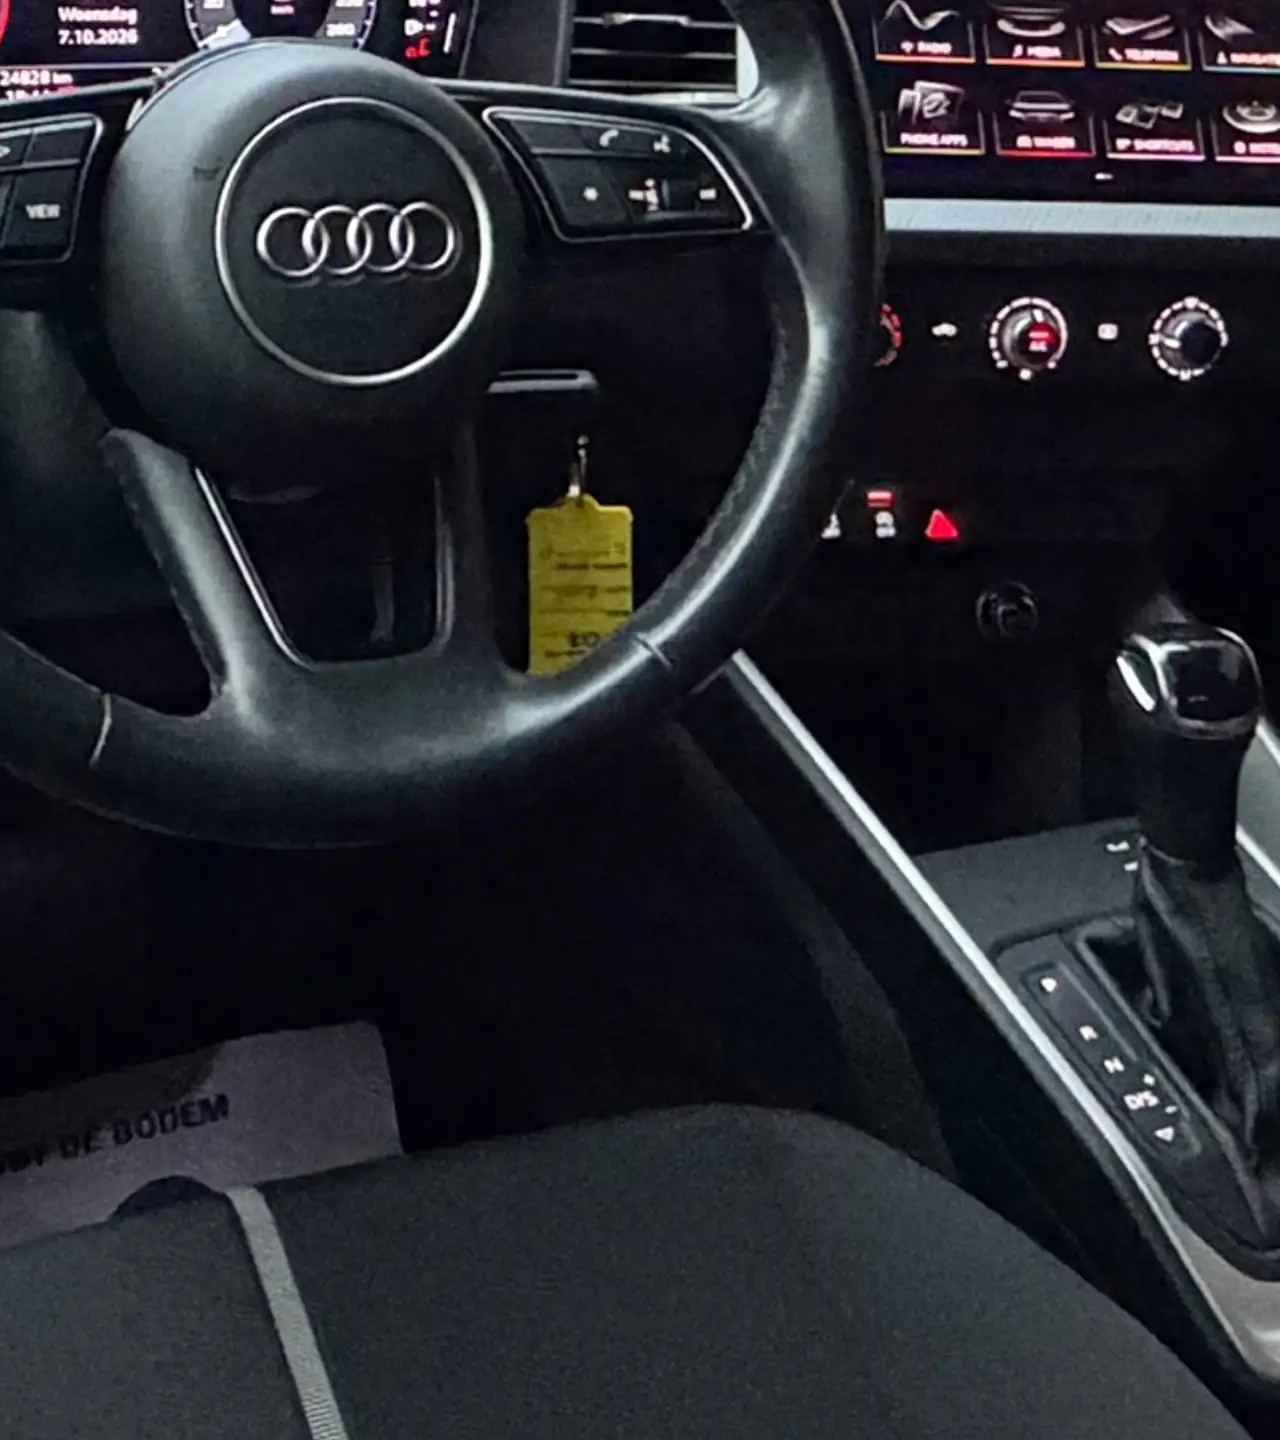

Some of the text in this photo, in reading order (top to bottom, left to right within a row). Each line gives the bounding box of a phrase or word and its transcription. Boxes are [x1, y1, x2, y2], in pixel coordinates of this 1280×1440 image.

[58, 7, 138, 25] Woensdag
[25, 204, 60, 219] VIEW
[113, 1093, 229, 1145] BODEM
